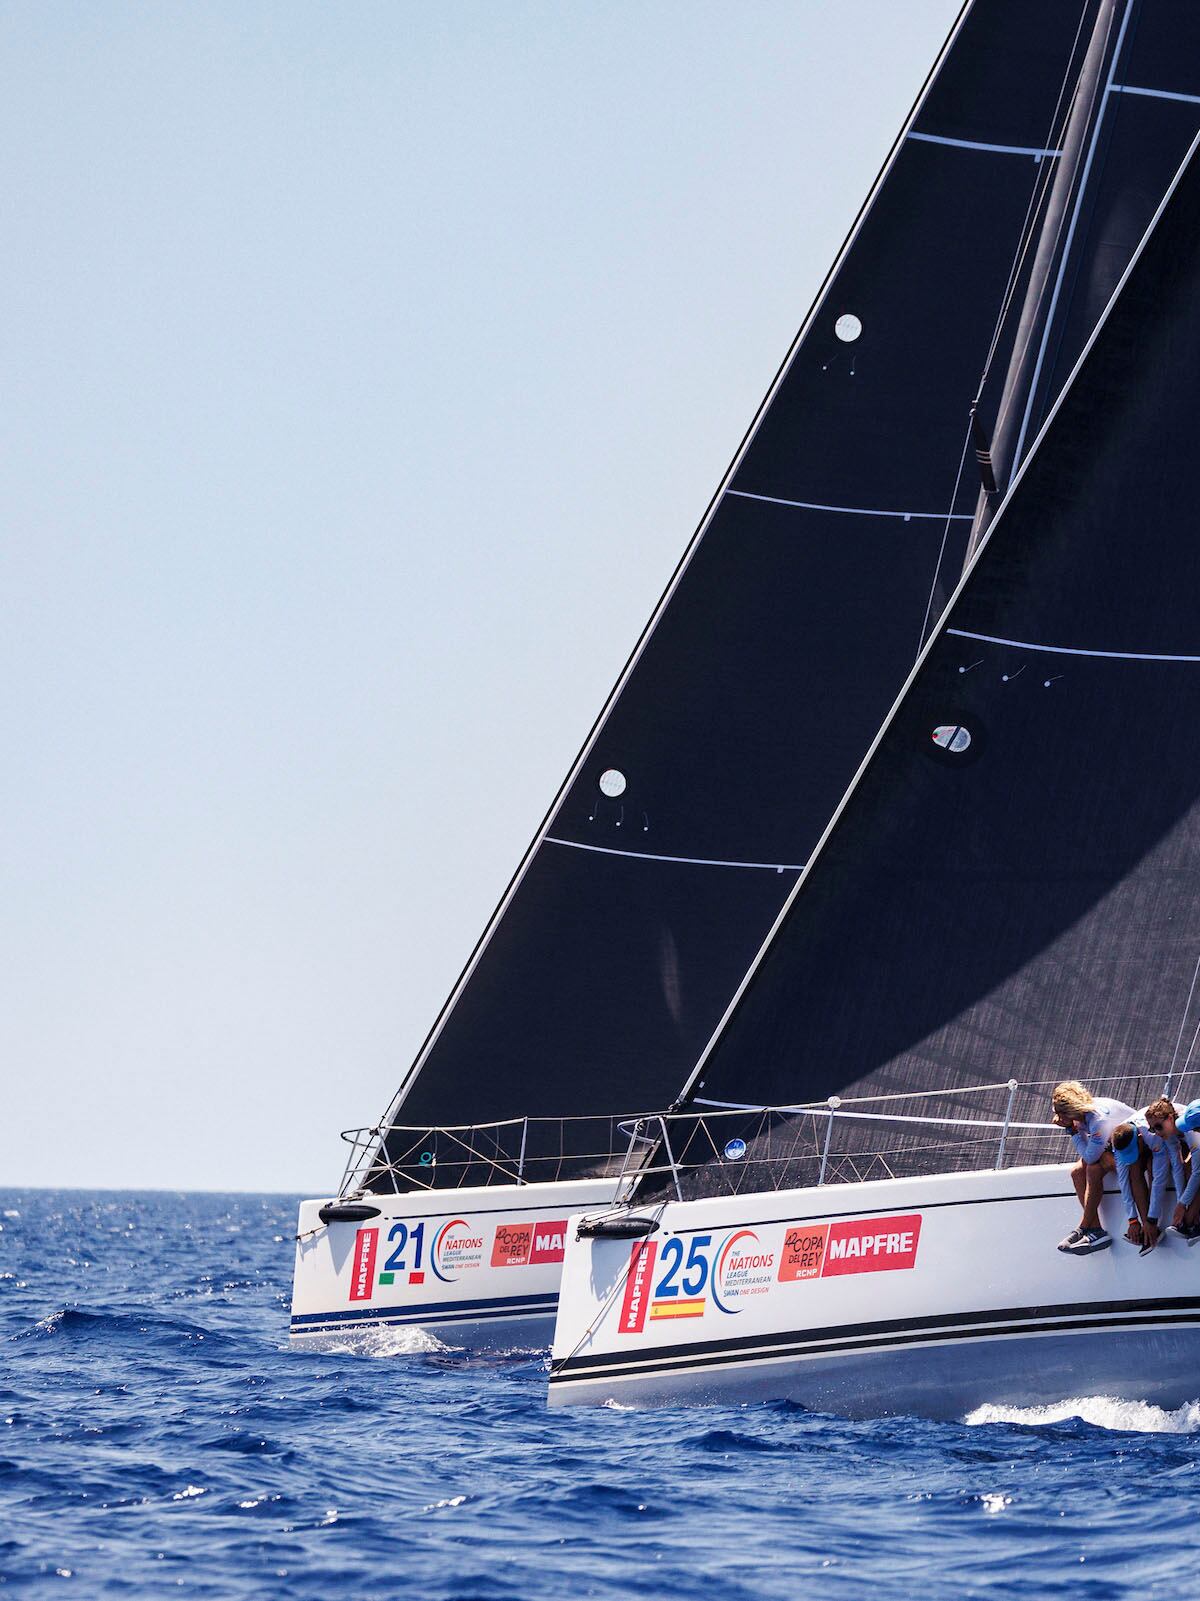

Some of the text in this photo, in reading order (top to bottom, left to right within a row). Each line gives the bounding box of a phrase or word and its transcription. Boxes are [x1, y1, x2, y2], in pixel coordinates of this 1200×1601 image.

[445, 1238, 483, 1250] NATIONS
[503, 1232, 530, 1245] COPA
[793, 1236, 823, 1252] COPA
[829, 1231, 914, 1260] MAPFRE
[384, 1222, 425, 1271] 21
[510, 1244, 529, 1256] REY
[356, 1231, 372, 1297] MAPFRE
[506, 1257, 526, 1265] RCNP
[655, 1235, 712, 1297] 25
[728, 1254, 774, 1271] NATIONS
[788, 1251, 822, 1267] DEL REY
[726, 1270, 748, 1279] LEAGUE
[796, 1268, 818, 1278] RCNP
[627, 1246, 649, 1329] MAPFRE
[724, 1276, 771, 1287] MEDITERRANEAN
[723, 1289, 739, 1298] SWAN
[750, 1286, 769, 1295] DESIGN
